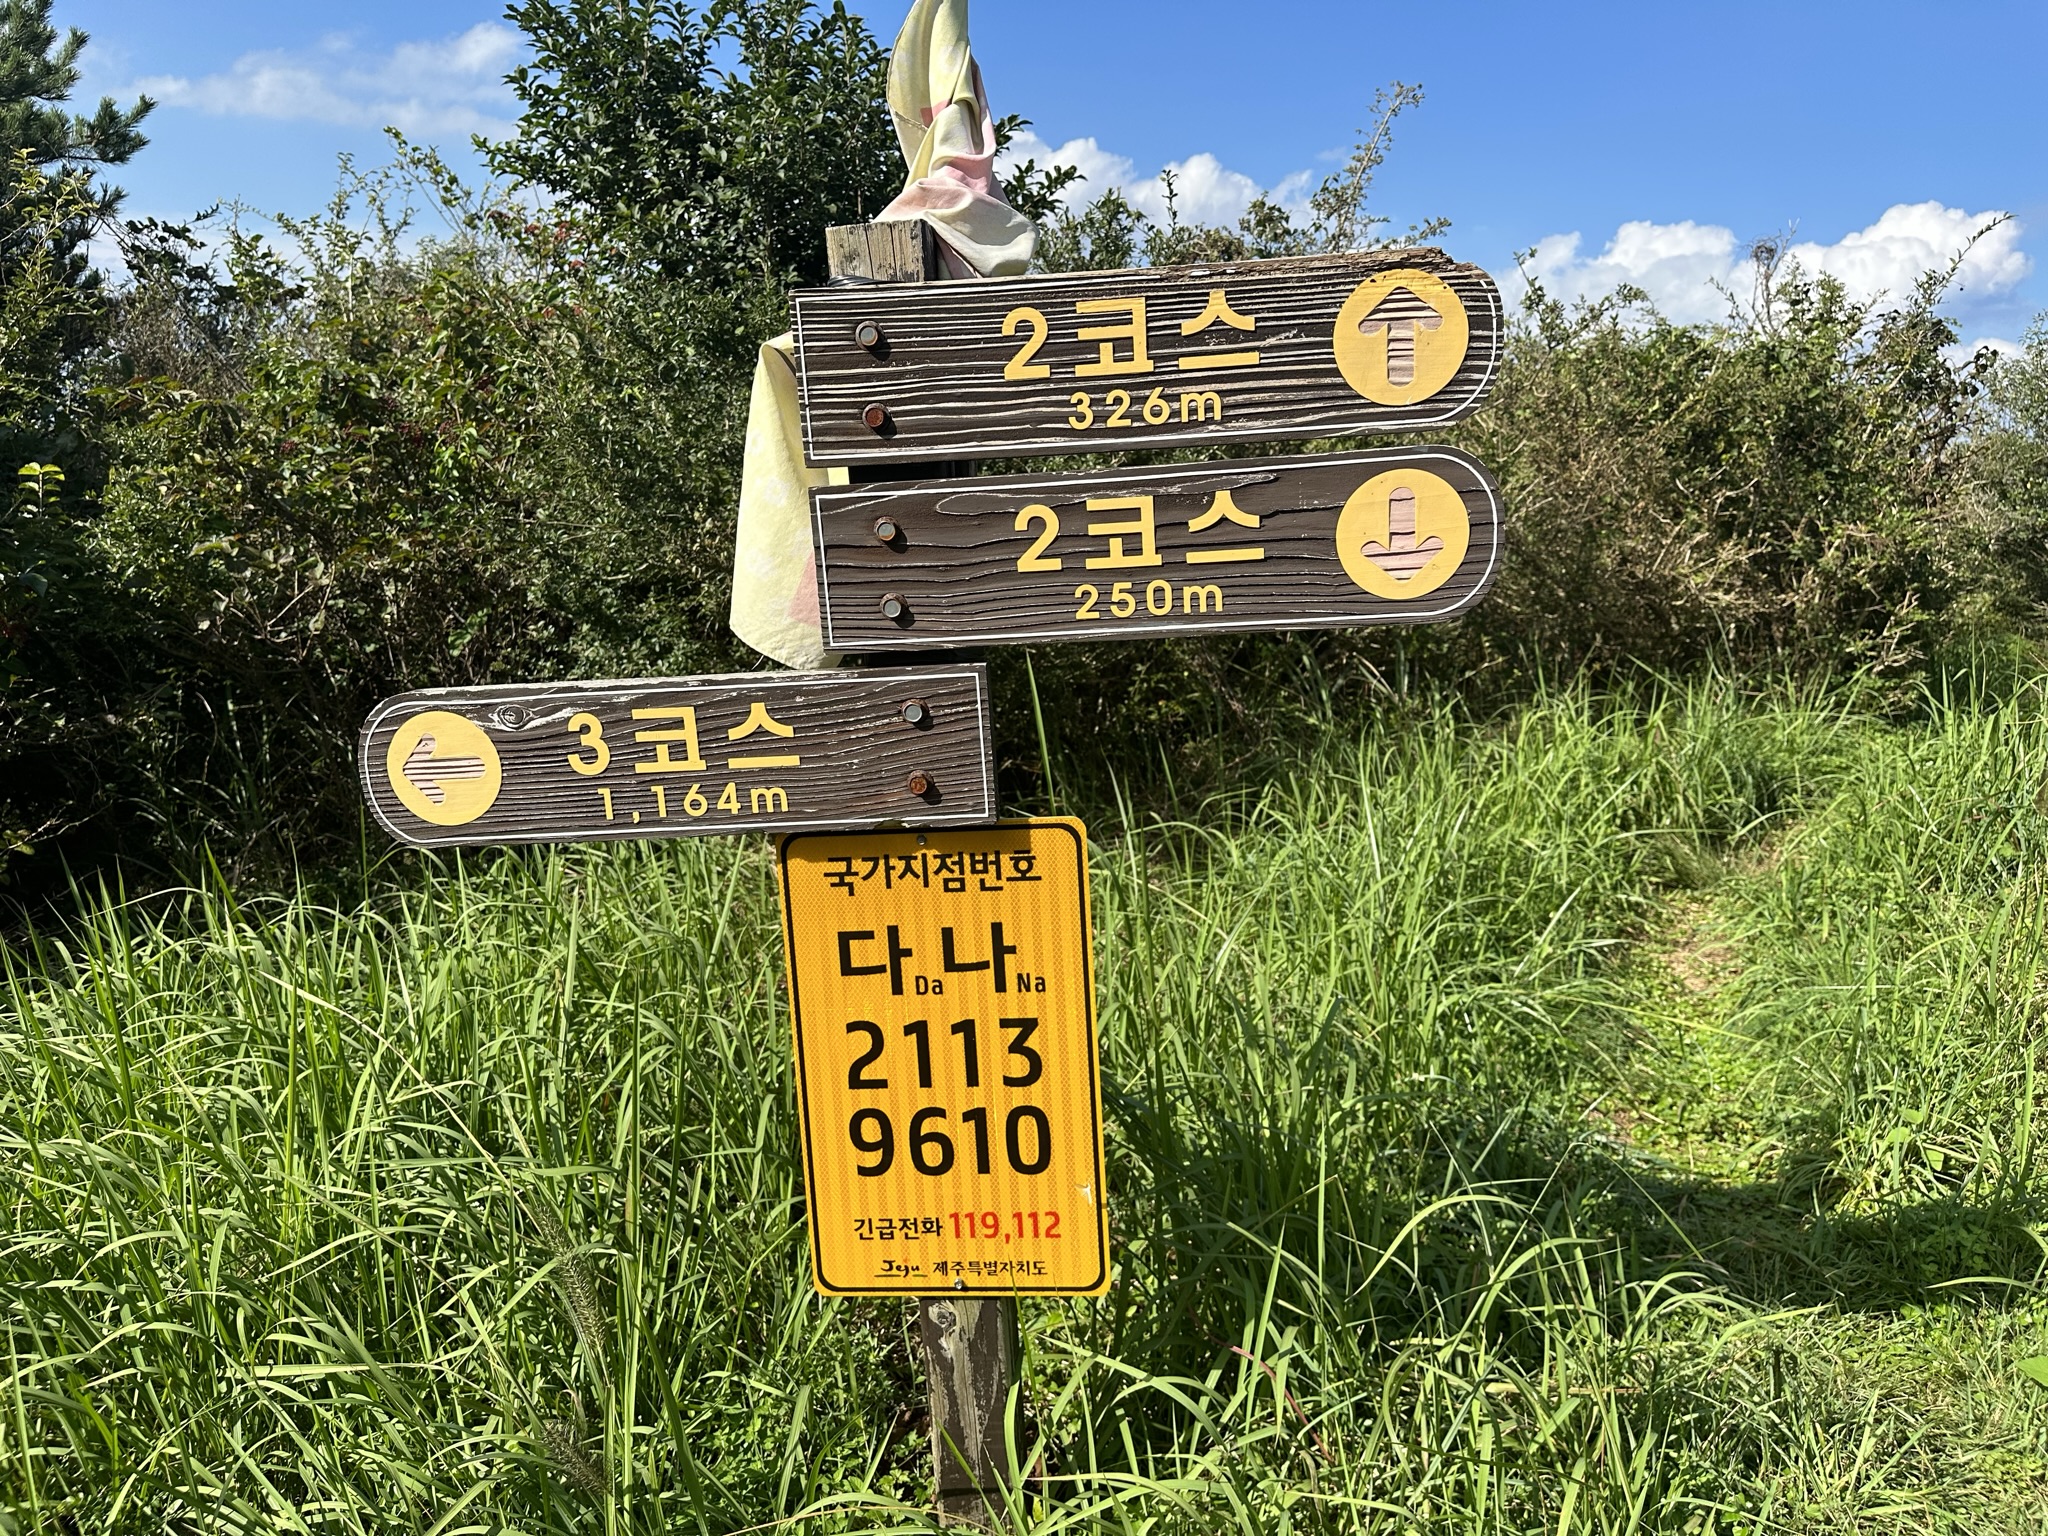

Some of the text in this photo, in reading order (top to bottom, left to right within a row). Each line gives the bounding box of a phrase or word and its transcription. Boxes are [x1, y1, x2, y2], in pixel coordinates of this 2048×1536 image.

[1068, 386, 1222, 430] 326m
[1075, 579, 1223, 620] 250m
[598, 782, 790, 824] 1,164m
[823, 850, 1042, 896] 국가지점번호
[846, 1018, 1043, 1091] 2113
[850, 1106, 1051, 1177] 9610
[854, 1211, 1062, 1244] 긴급전화 119,112
[878, 1259, 1048, 1279] Jeju 제주특별자치도
